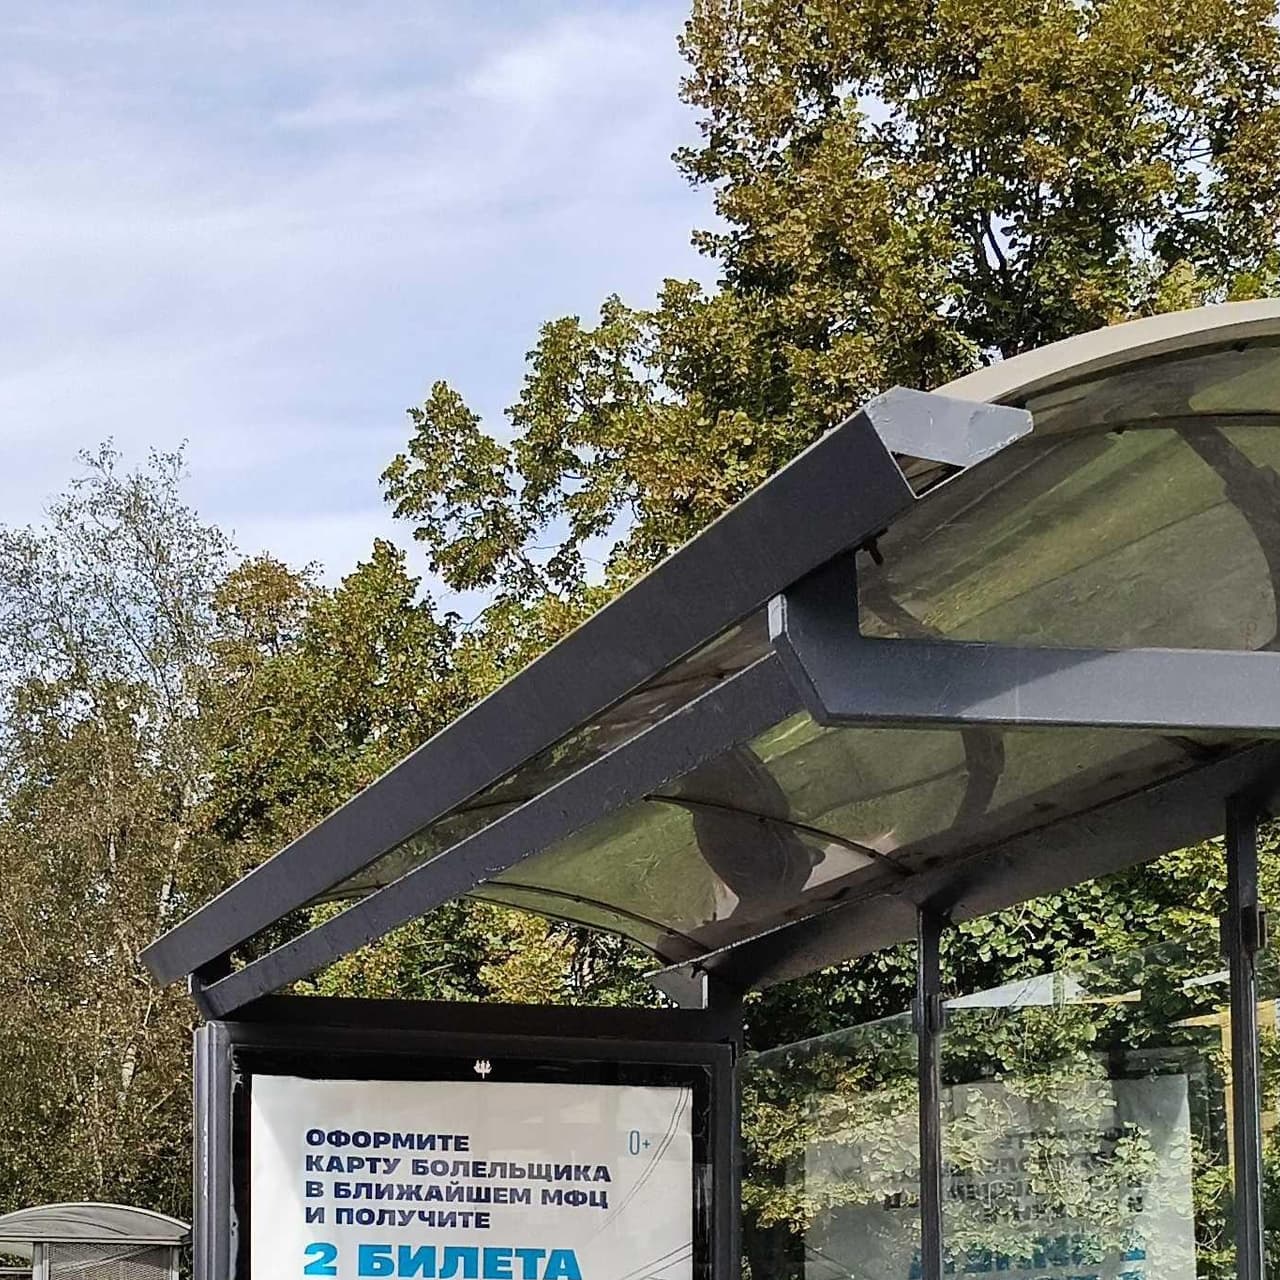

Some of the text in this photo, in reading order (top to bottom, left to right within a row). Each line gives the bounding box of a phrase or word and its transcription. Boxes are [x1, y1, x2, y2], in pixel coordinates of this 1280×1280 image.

[305, 1128, 470, 1152] ОФОРМИТЕ
[628, 1130, 651, 1156] 0+
[305, 1155, 611, 1182] КАРТУ БОЛЕЛЬЩИКА
[305, 1180, 609, 1209] В БЛИЖАЙШЕМ МФЦ
[305, 1207, 491, 1230] И ПОЛУЧИТЕ
[304, 1242, 338, 1276] 2
